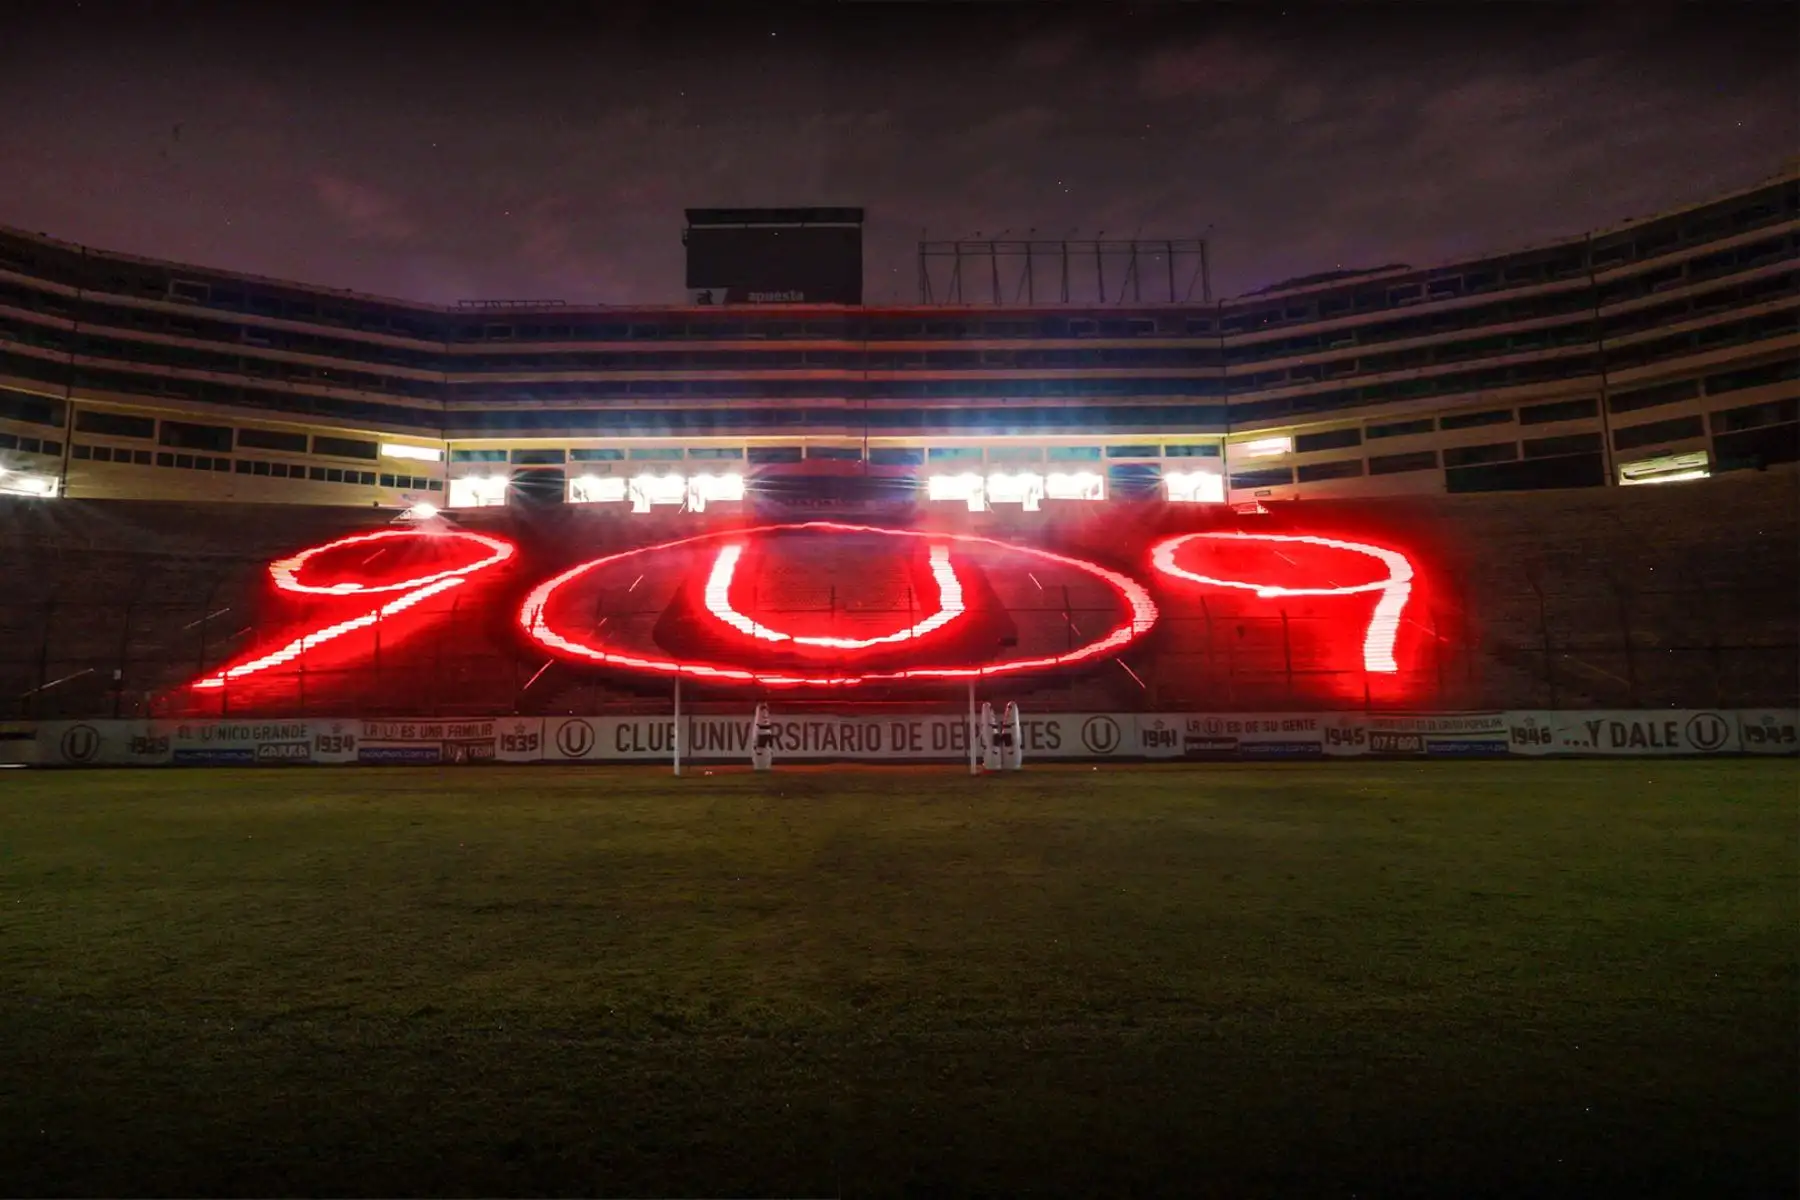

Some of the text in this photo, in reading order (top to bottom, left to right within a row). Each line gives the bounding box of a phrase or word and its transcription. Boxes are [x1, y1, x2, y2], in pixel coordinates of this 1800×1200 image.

[748, 291, 804, 304] apuesta
[253, 723, 309, 740] GRANDE
[401, 725, 416, 738] ES
[420, 725, 443, 738] UNA
[447, 723, 493, 738] FAMILIA
[1227, 721, 1241, 733] ES
[1245, 721, 1259, 733] DE
[1263, 721, 1278, 732] SU
[1282, 719, 1317, 732] GENTE
[1510, 725, 1552, 745] 1946
[1610, 721, 1679, 748] DALE
[314, 733, 356, 754] 1934
[500, 732, 539, 753] 1939
[692, 721, 882, 752] UNIVRSITARIO
[891, 722, 923, 752] DE
[932, 721, 1061, 750] DEPTES
[1142, 729, 1177, 748] 1941
[1324, 727, 1365, 746] 1945
